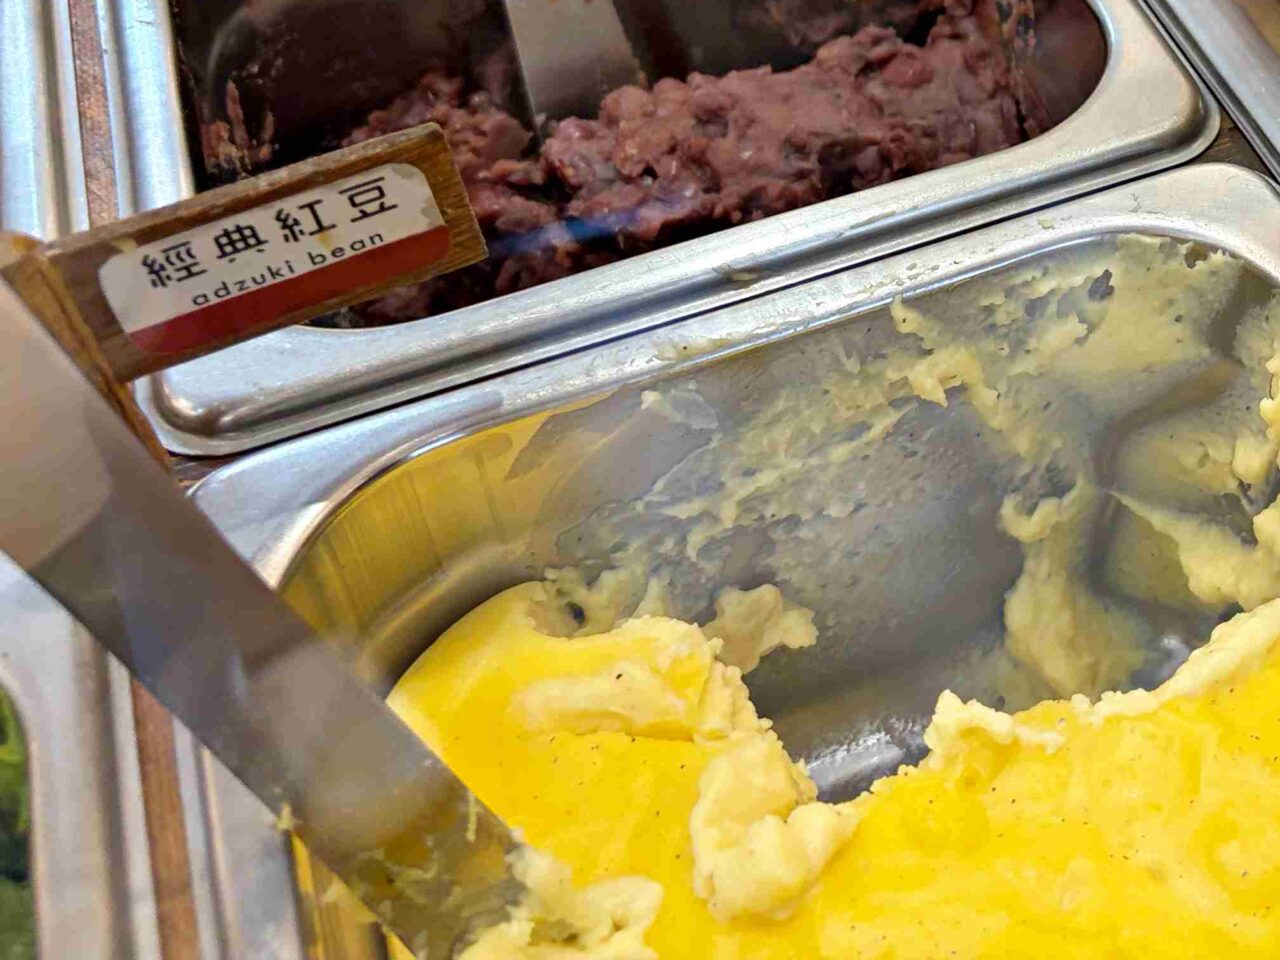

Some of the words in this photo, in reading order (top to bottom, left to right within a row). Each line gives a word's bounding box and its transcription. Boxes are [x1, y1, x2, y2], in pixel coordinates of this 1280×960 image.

[141, 176, 398, 288] 經典紅豆
[192, 259, 296, 306] adzuki
[308, 232, 385, 267] bean
